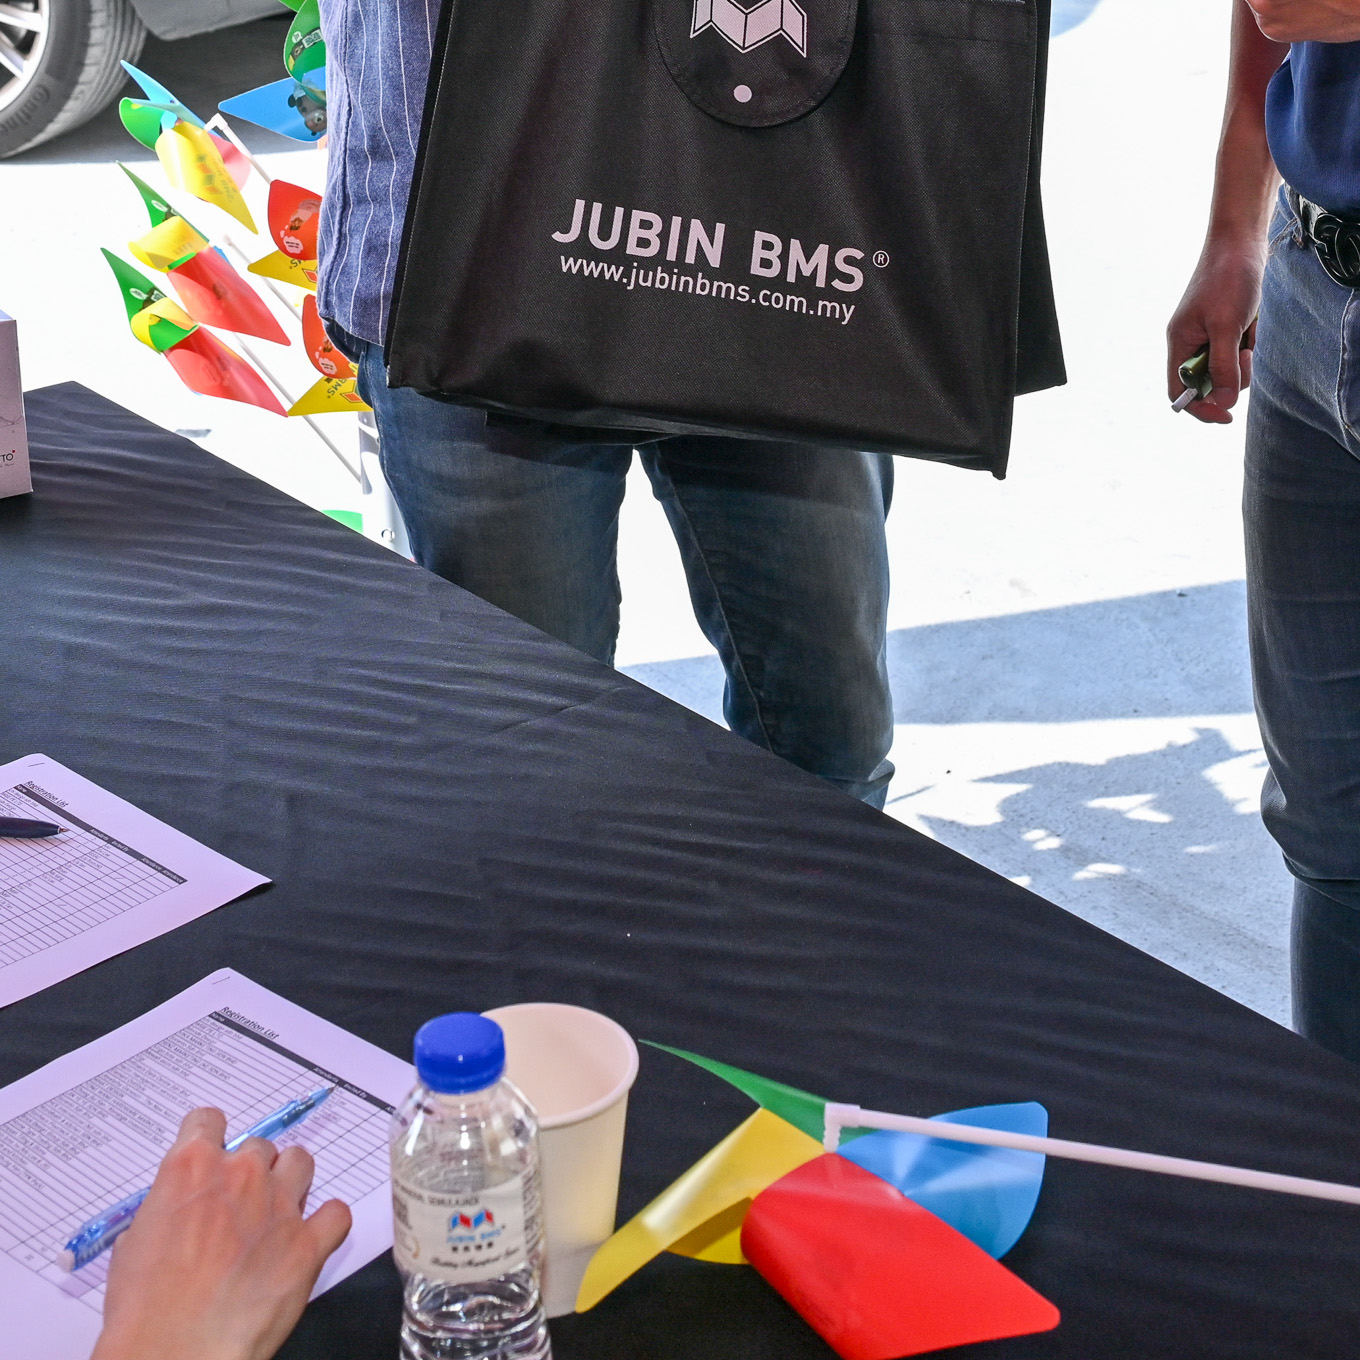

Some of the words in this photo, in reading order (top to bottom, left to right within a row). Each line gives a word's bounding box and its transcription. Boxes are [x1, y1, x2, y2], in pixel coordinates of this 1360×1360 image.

[551, 198, 726, 268] JUBIN
[559, 254, 856, 325] www.jubinbms.com.my
[218, 1006, 267, 1032] Registration
[261, 1029, 280, 1039] List
